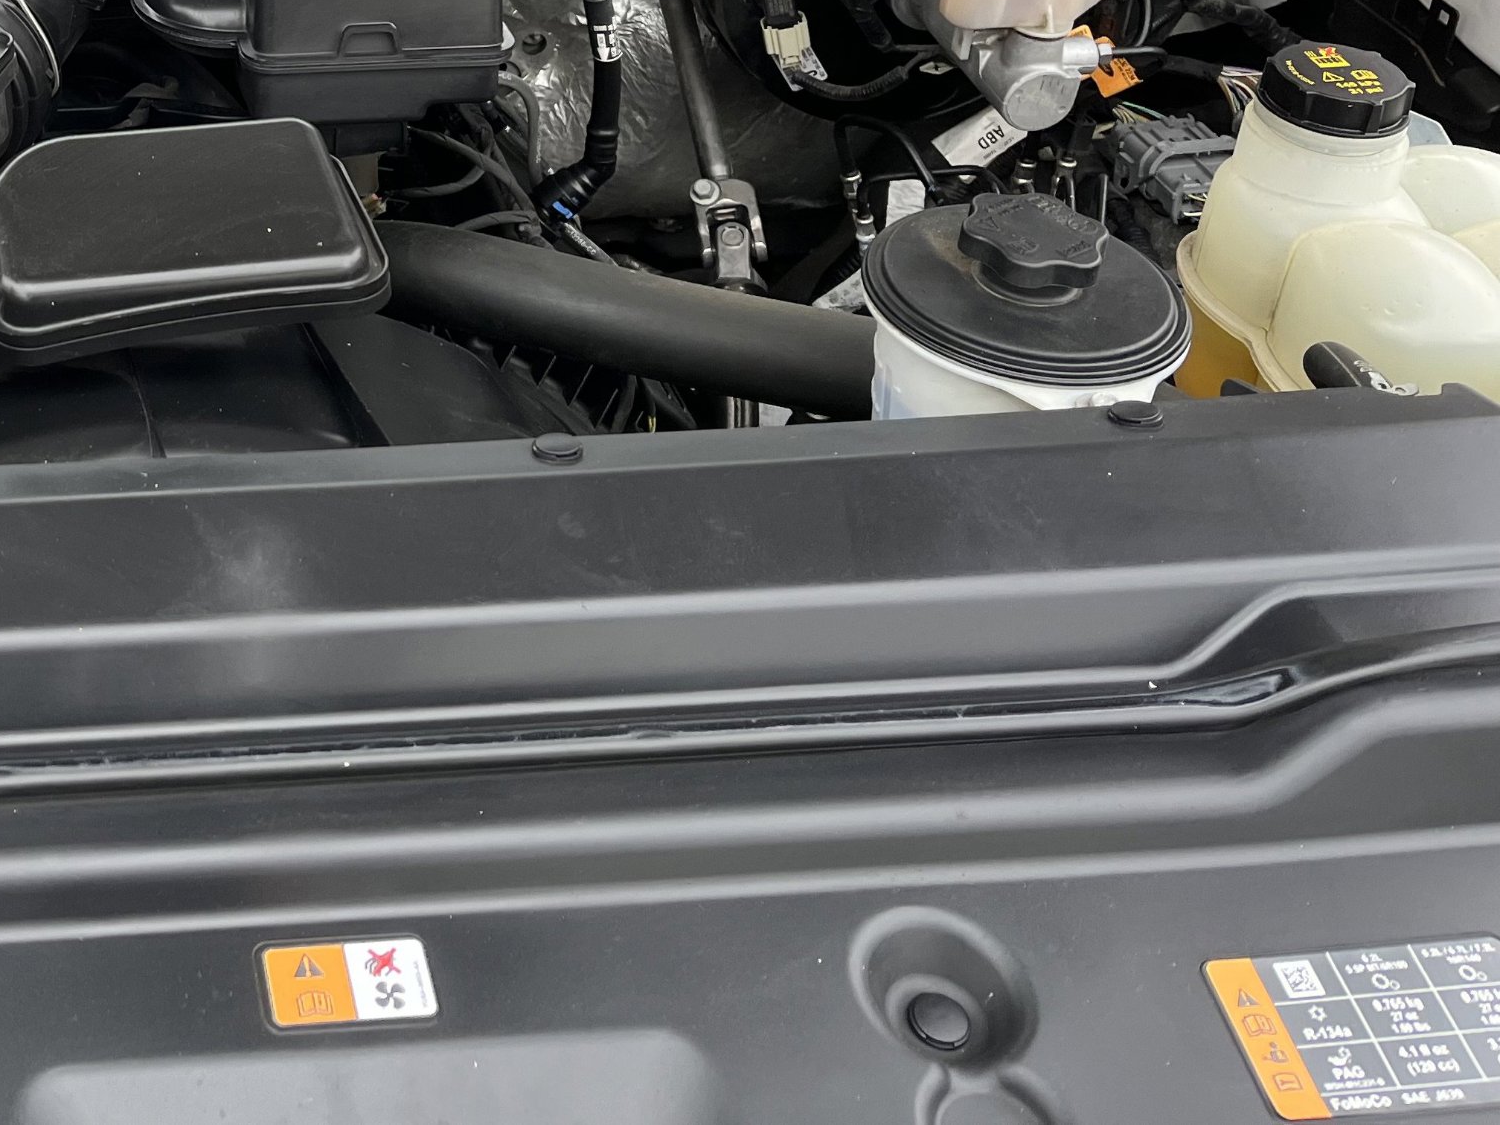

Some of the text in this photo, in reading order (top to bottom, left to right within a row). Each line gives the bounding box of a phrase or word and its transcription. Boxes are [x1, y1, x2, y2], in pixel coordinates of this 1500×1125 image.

[978, 125, 1006, 149] ABD
[1372, 996, 1425, 1012] 0.765 kg
[1390, 1010, 1419, 1023] 27 oz
[1302, 1025, 1353, 1041] R-134a
[1398, 1045, 1418, 1059] 4.1
[1431, 1044, 1450, 1056] oz
[1332, 1064, 1366, 1081] PAG
[1406, 1057, 1461, 1078] (120 cc)
[1329, 1087, 1465, 1112] FoMoCo SAE J639
